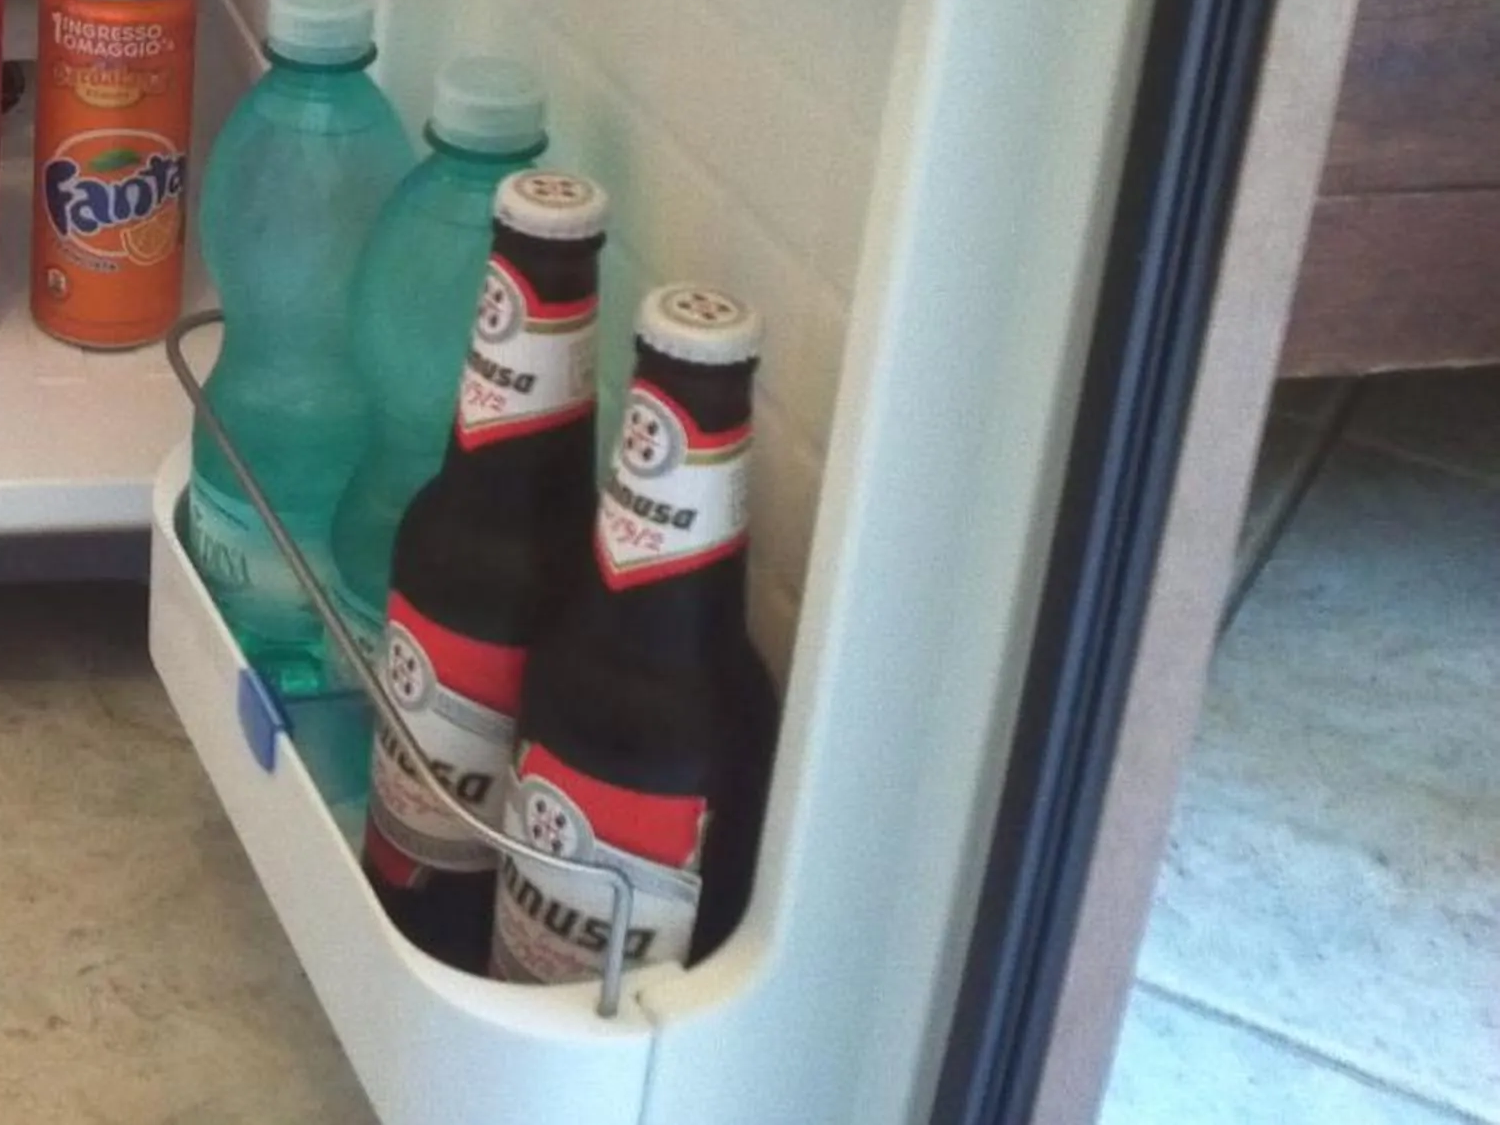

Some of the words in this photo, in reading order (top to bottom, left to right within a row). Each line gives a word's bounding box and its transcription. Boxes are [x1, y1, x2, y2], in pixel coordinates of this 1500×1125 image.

[62, 16, 162, 43] INGRESSO
[63, 34, 161, 59] OMAGGIO
[45, 153, 187, 236] Fanta
